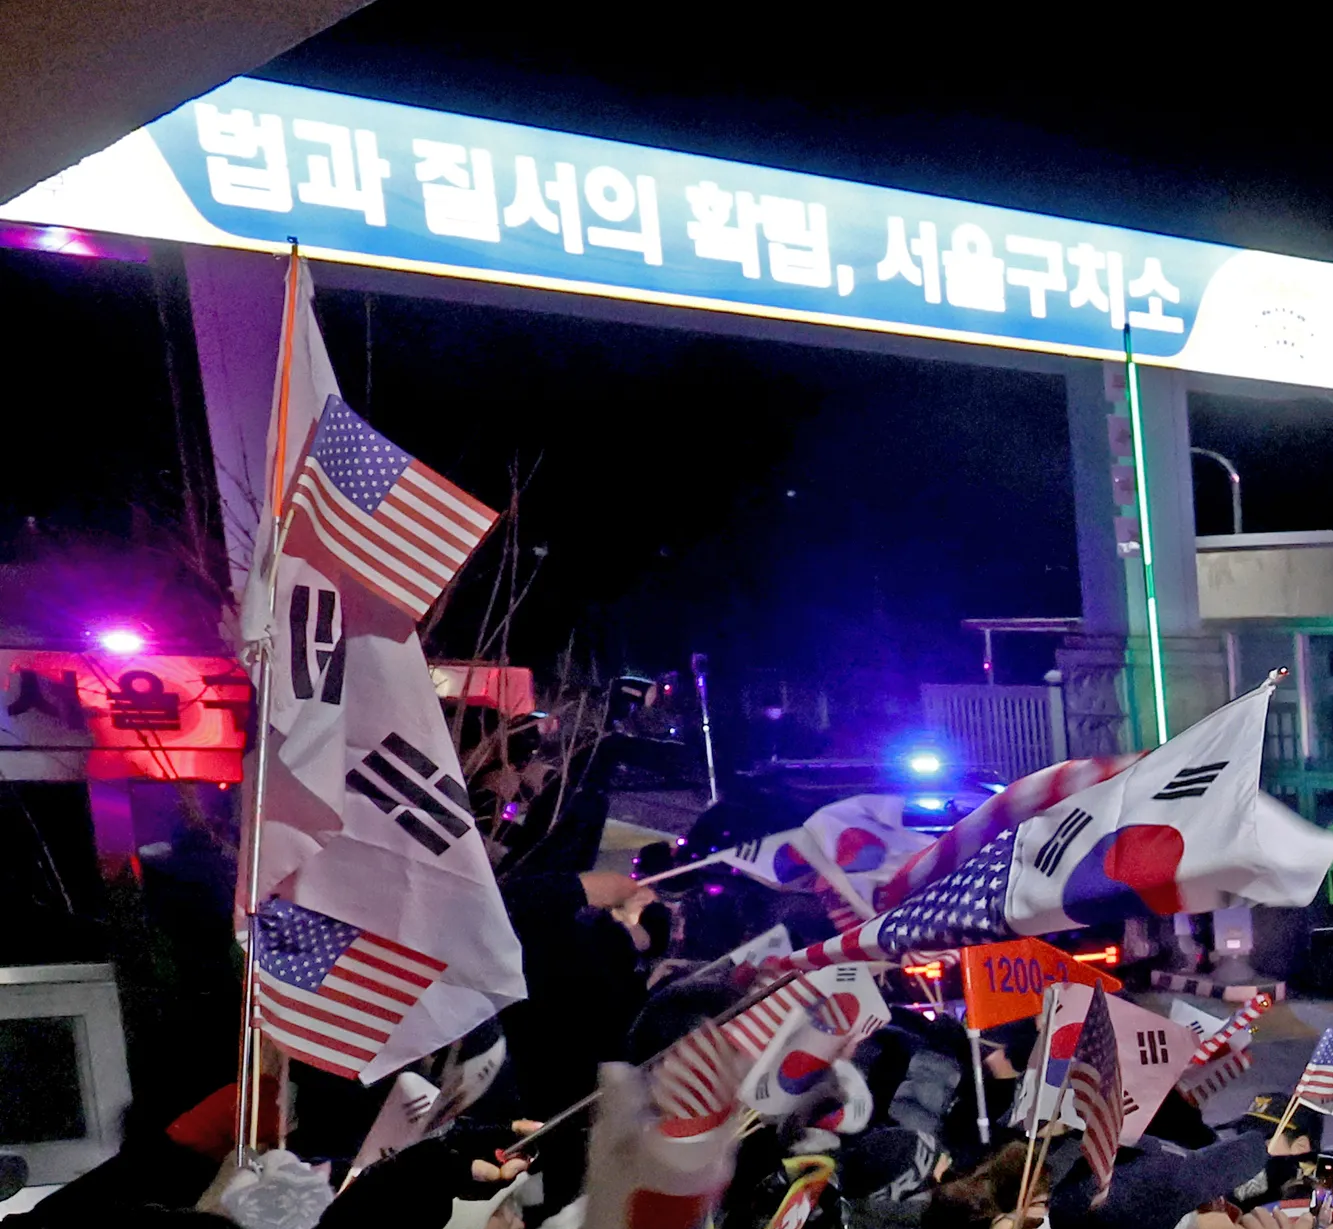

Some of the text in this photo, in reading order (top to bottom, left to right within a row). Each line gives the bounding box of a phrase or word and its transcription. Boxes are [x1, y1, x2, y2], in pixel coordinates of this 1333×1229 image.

[196, 103, 391, 227] 법과
[412, 139, 664, 266] 질서의
[686, 181, 854, 298] 확립,
[877, 216, 1185, 335] 서울구치소
